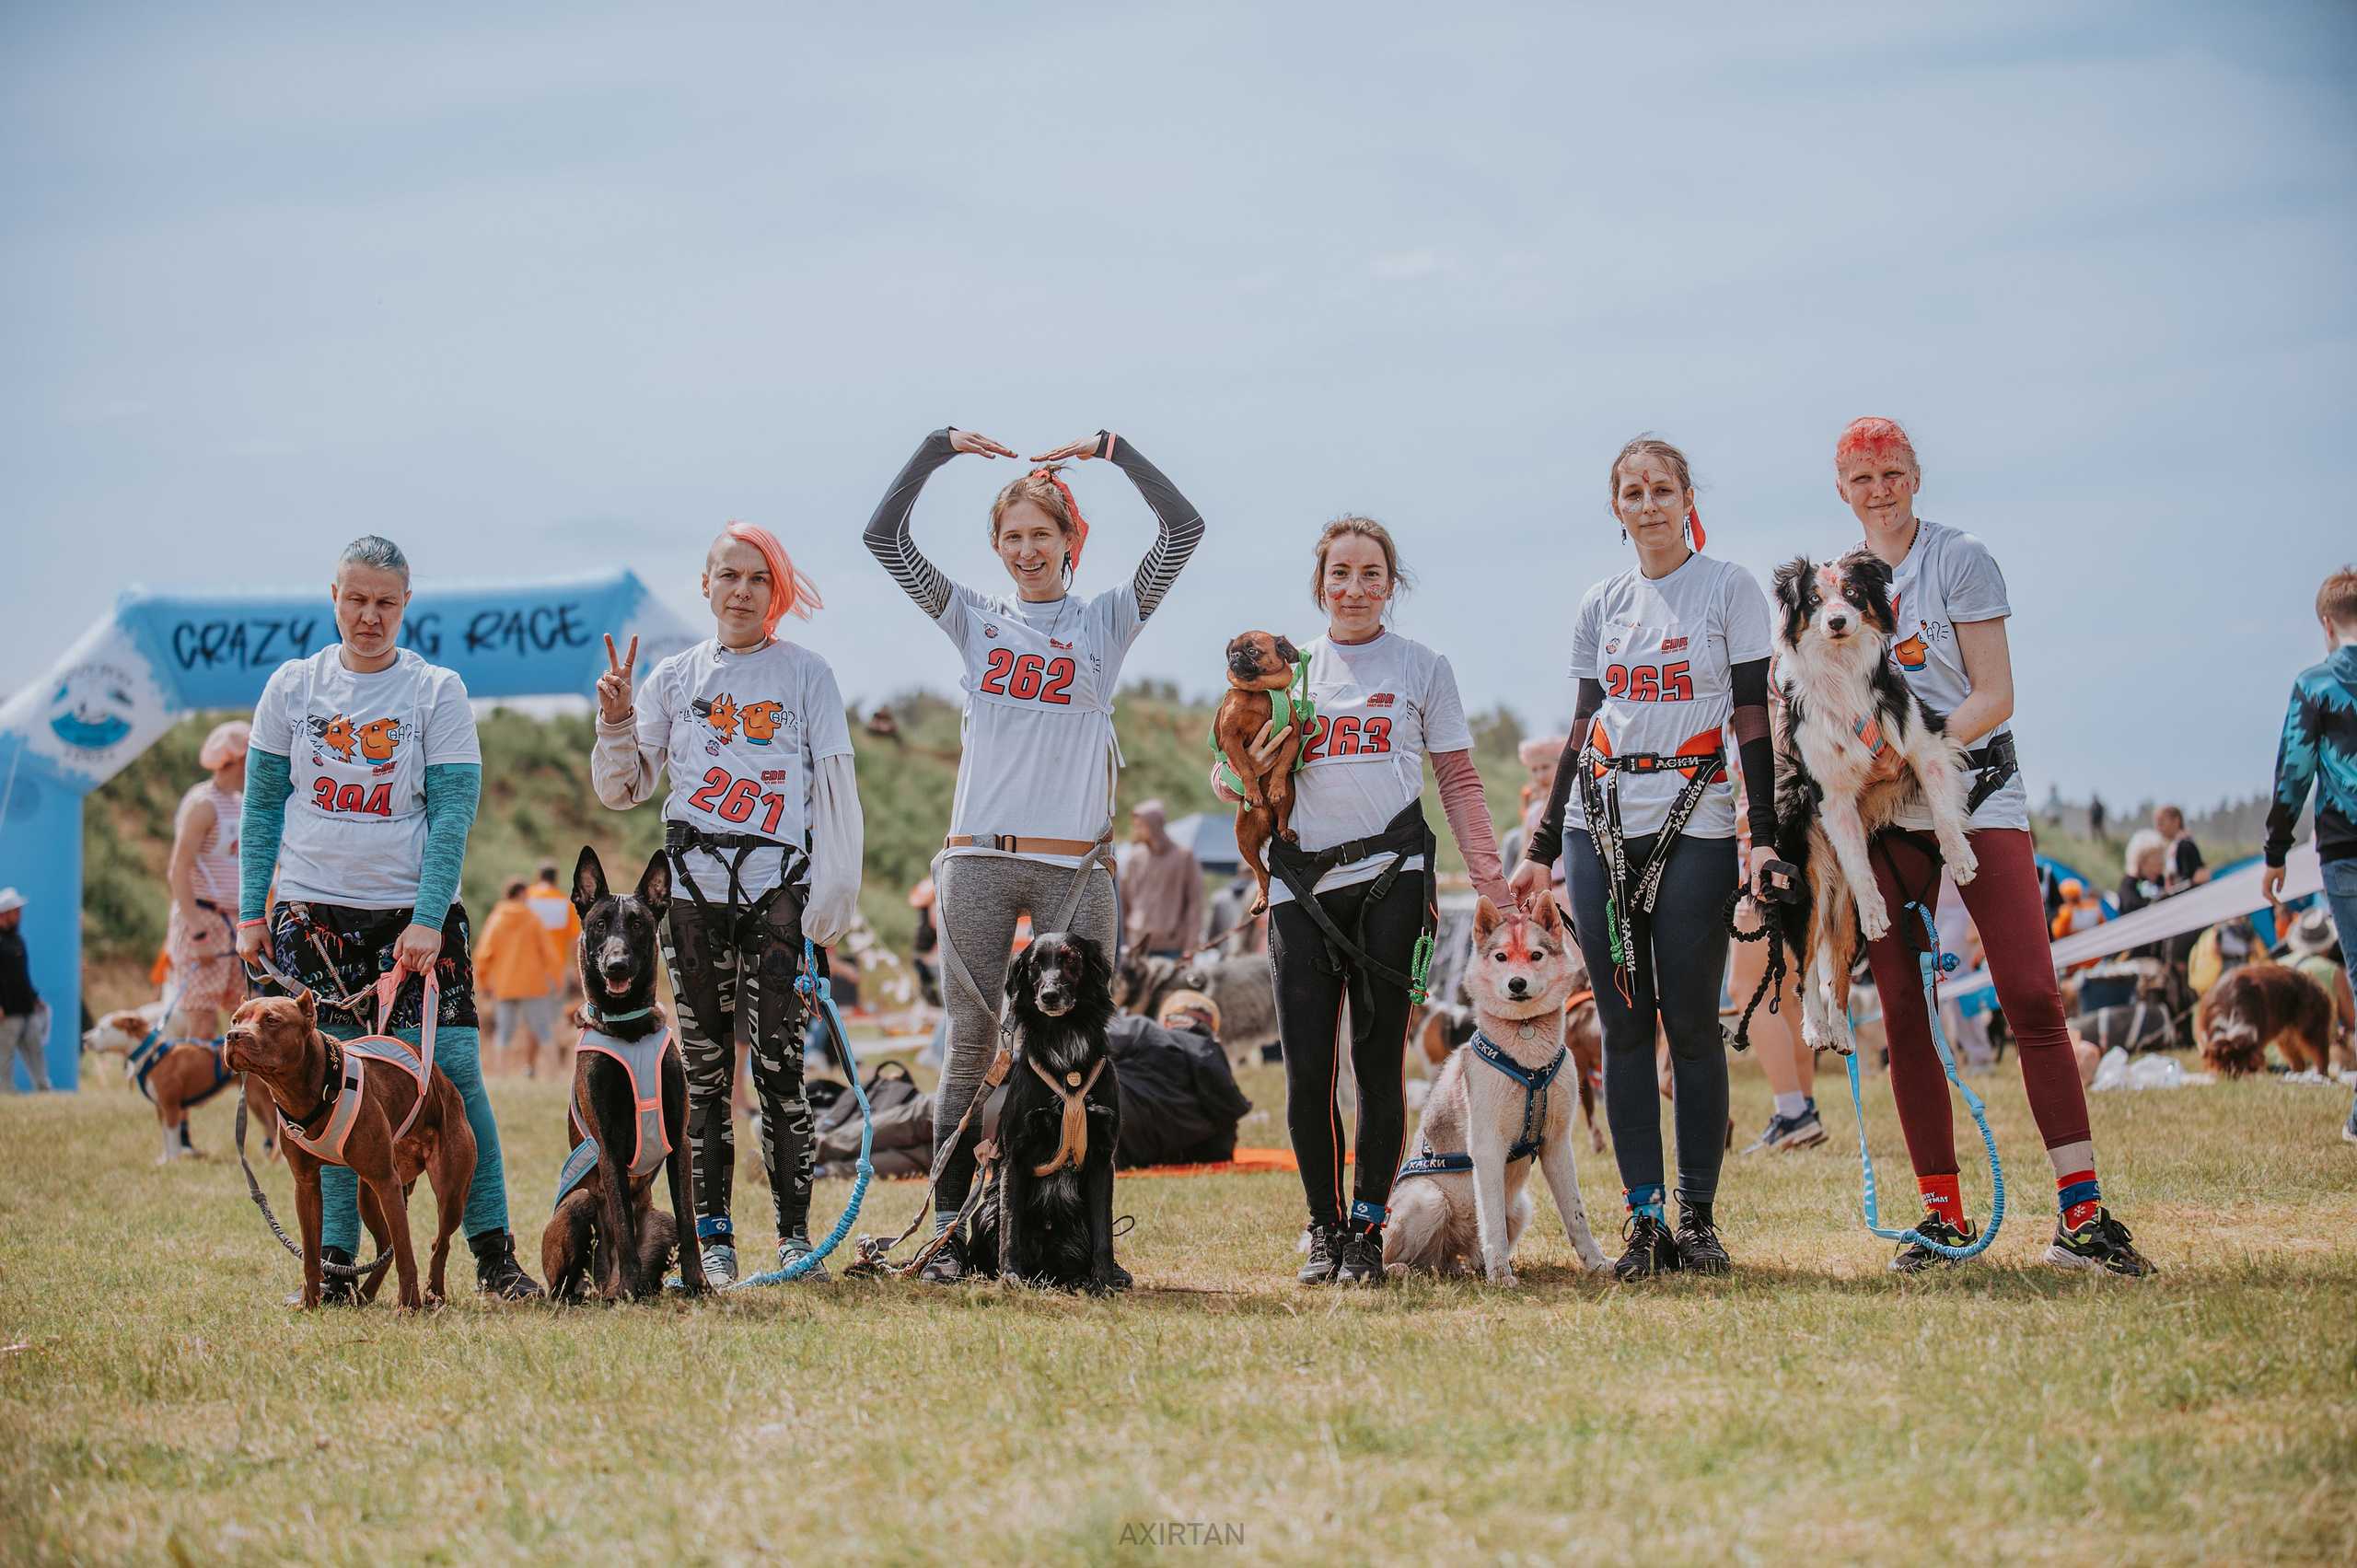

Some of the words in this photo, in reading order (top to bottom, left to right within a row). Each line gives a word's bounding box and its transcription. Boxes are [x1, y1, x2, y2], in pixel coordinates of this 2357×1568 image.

[172, 620, 317, 671] CRAZY
[465, 603, 592, 656] RACE
[1661, 636, 1689, 651] CDR
[981, 648, 1075, 704] 262
[1366, 692, 1395, 704] CDR
[1606, 660, 1694, 702] 265
[1303, 715, 1392, 762] 263
[761, 770, 786, 781] CDR
[1656, 756, 1699, 769] АСКИ
[311, 776, 393, 817] 394
[688, 766, 784, 835] 261
[1672, 779, 1705, 831] ХАСКИ
[1611, 825, 1626, 881] ХАСКИ
[1621, 917, 1637, 972] ХАСКИ
[1409, 1158, 1446, 1169] ХАСКИ
